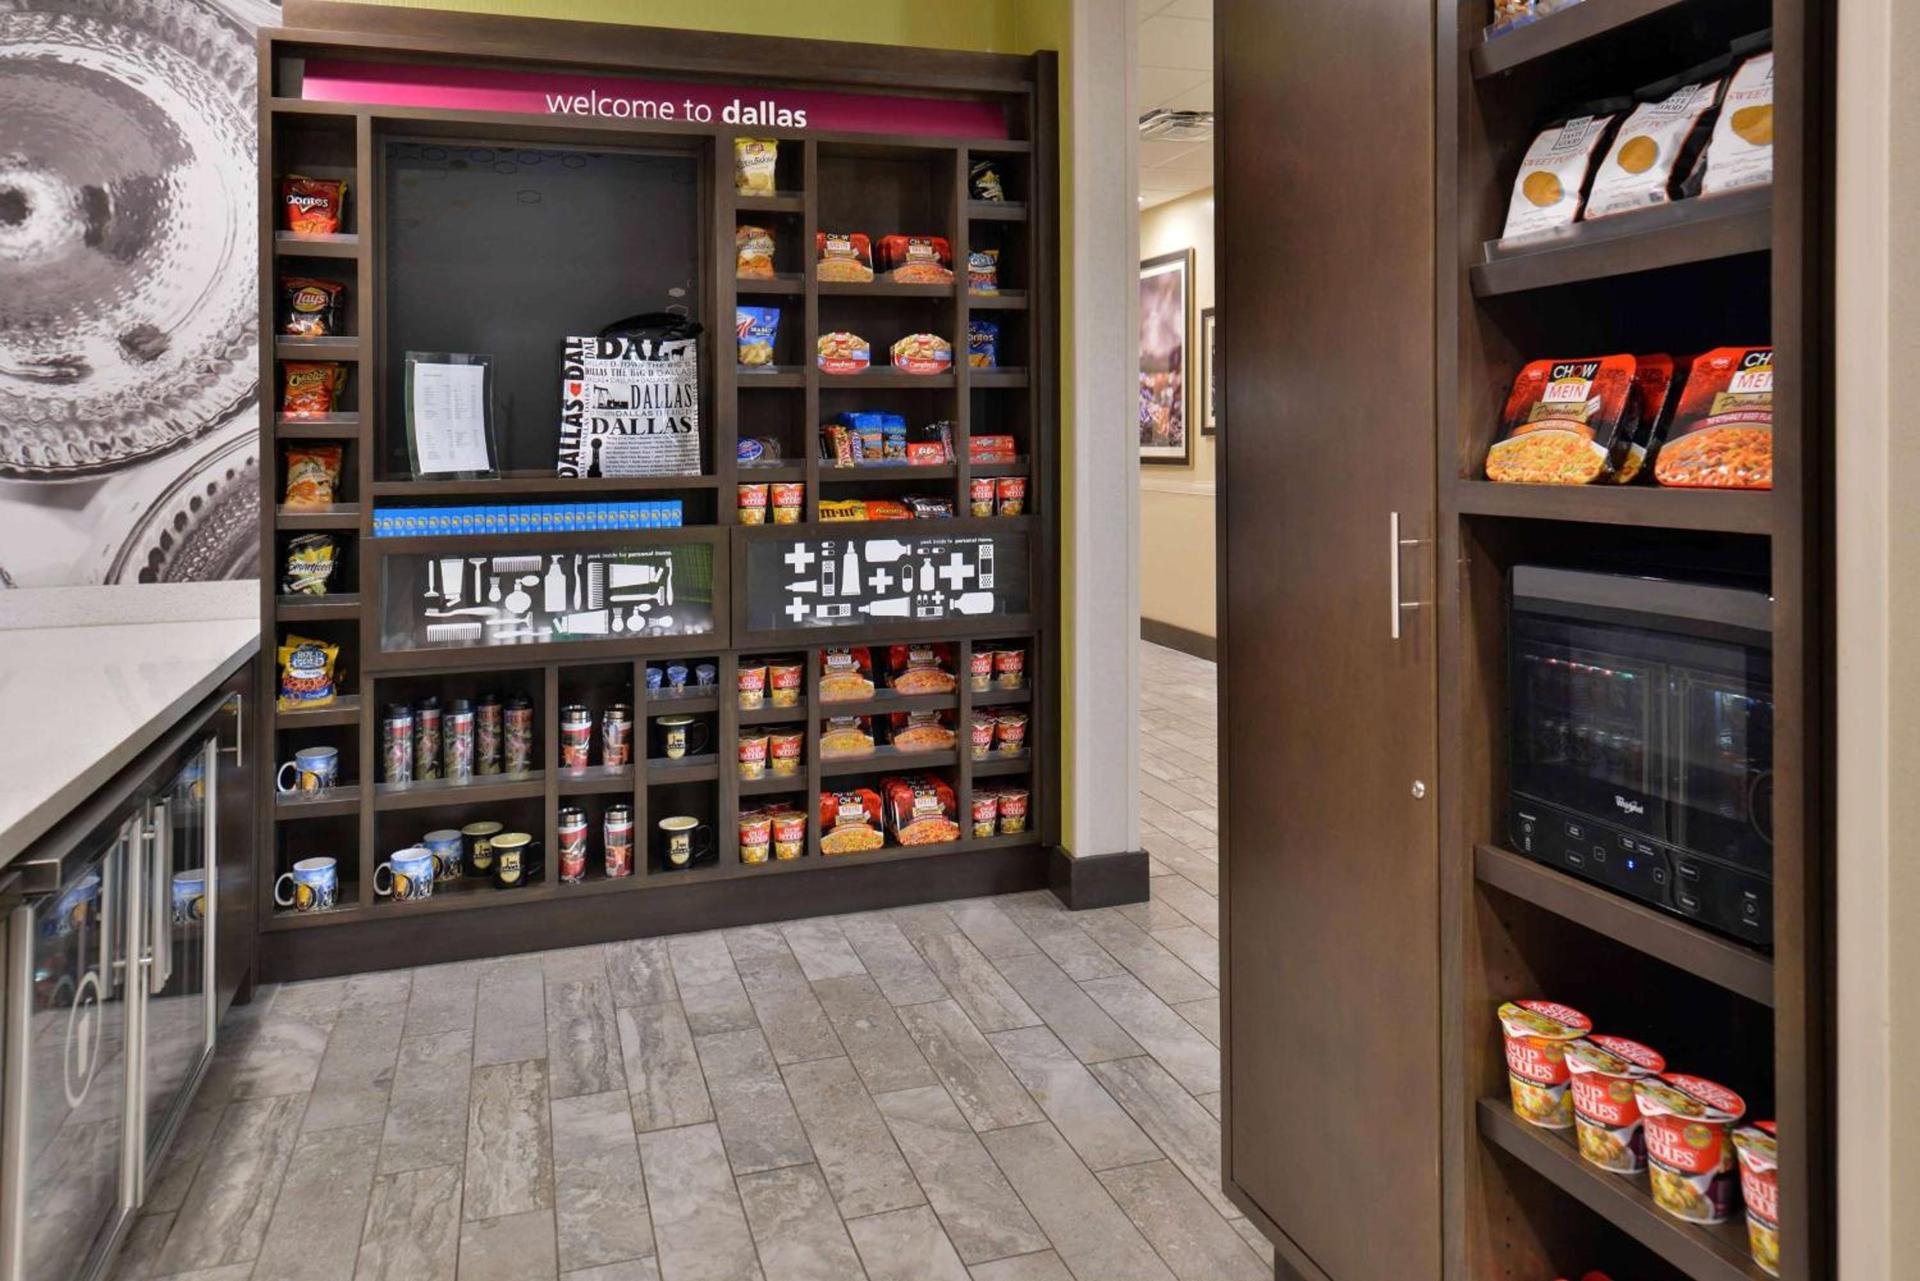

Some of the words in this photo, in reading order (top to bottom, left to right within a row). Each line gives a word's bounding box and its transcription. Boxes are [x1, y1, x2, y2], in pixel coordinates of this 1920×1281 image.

[545, 90, 675, 120] welcome
[684, 99, 712, 122] to
[722, 99, 808, 128] dallas
[286, 194, 329, 208] Doritos
[969, 332, 994, 343] oritos
[1744, 351, 1773, 367] CH
[1553, 363, 1598, 379] CHOW
[1736, 371, 1774, 389] MEI
[631, 383, 693, 410] DALLAS
[1549, 384, 1586, 399] MEIN
[591, 415, 693, 436] DALLAS
[560, 399, 585, 478] DALLAS
[1507, 1039, 1539, 1061] CUP
